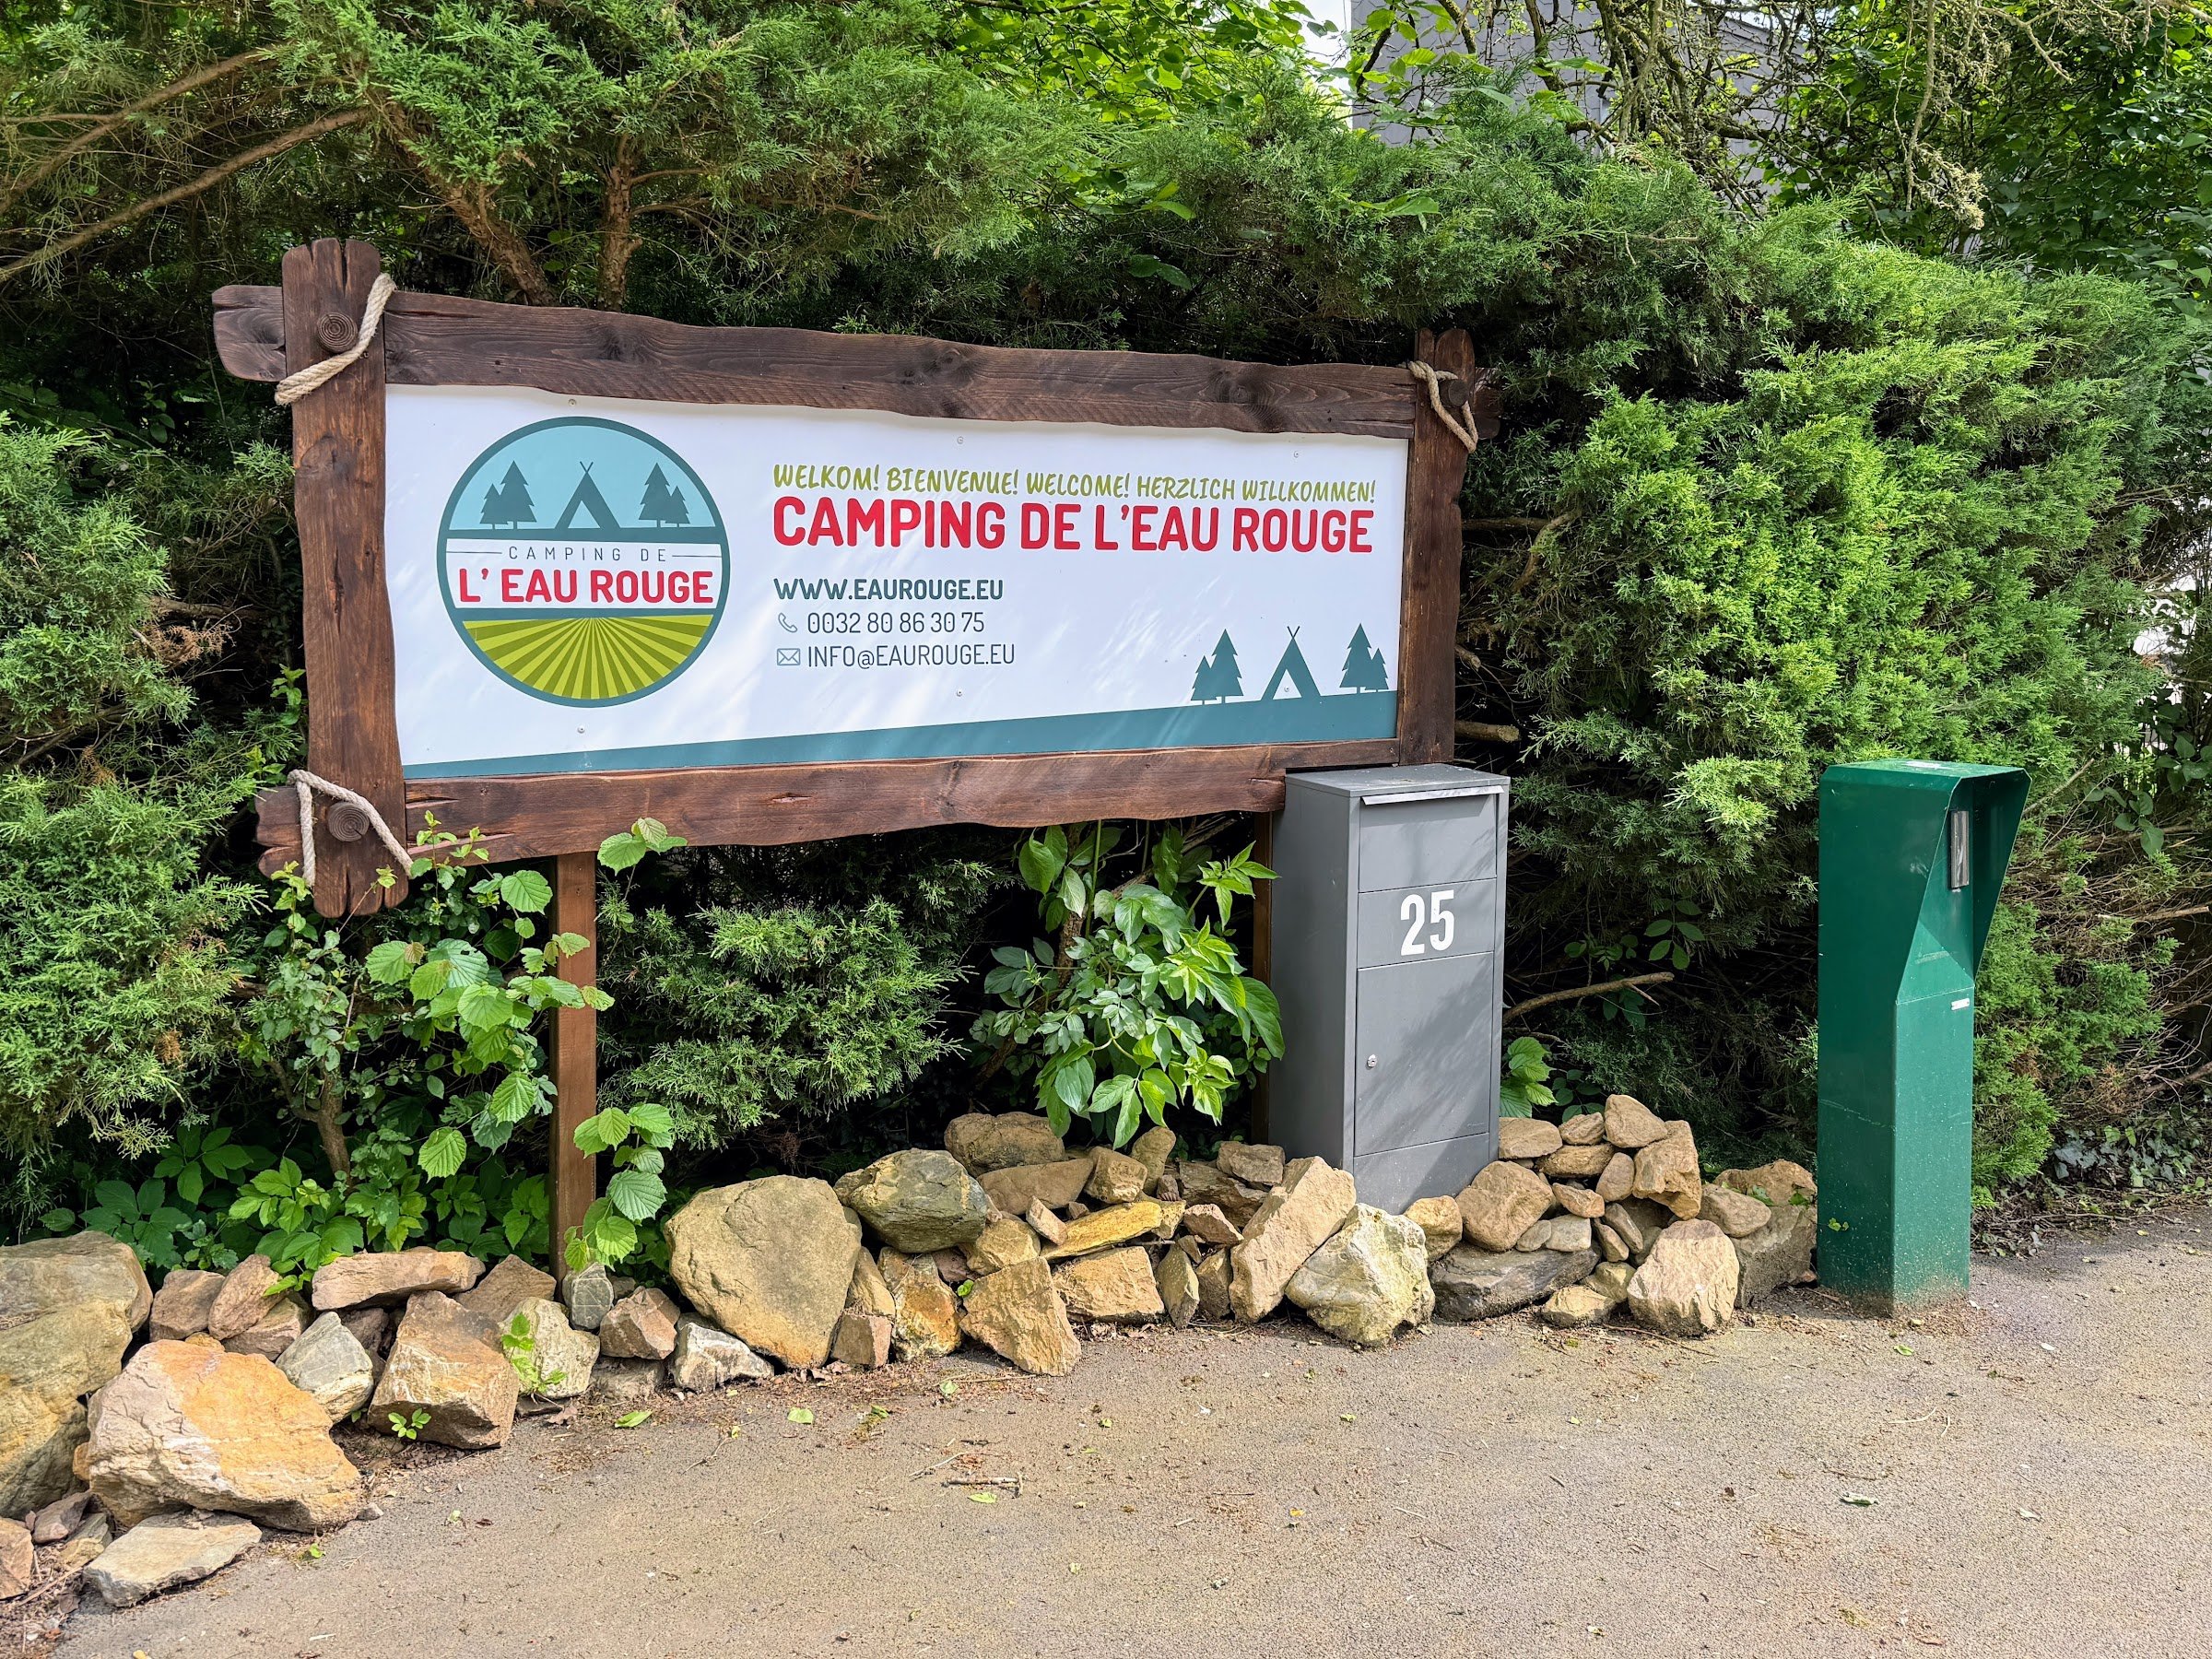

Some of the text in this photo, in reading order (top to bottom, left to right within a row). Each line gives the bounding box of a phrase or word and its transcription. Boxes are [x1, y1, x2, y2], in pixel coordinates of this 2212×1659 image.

[773, 463, 1377, 503] WELKOM! BIENVENUE! WELCOME! HERZLICH WILLKOMMEN!
[773, 496, 1374, 553] CAMPING DE L'EAU ROUGE
[508, 546, 665, 562] CAMPING DE
[590, 570, 713, 604] ROUGE
[772, 578, 1005, 601] WWW.EAUROUGE.EU
[806, 611, 985, 634] 0032 80 86 30 75
[807, 643, 1016, 670] INFO@EAUROUGE.EU
[1400, 889, 1455, 957] 25
